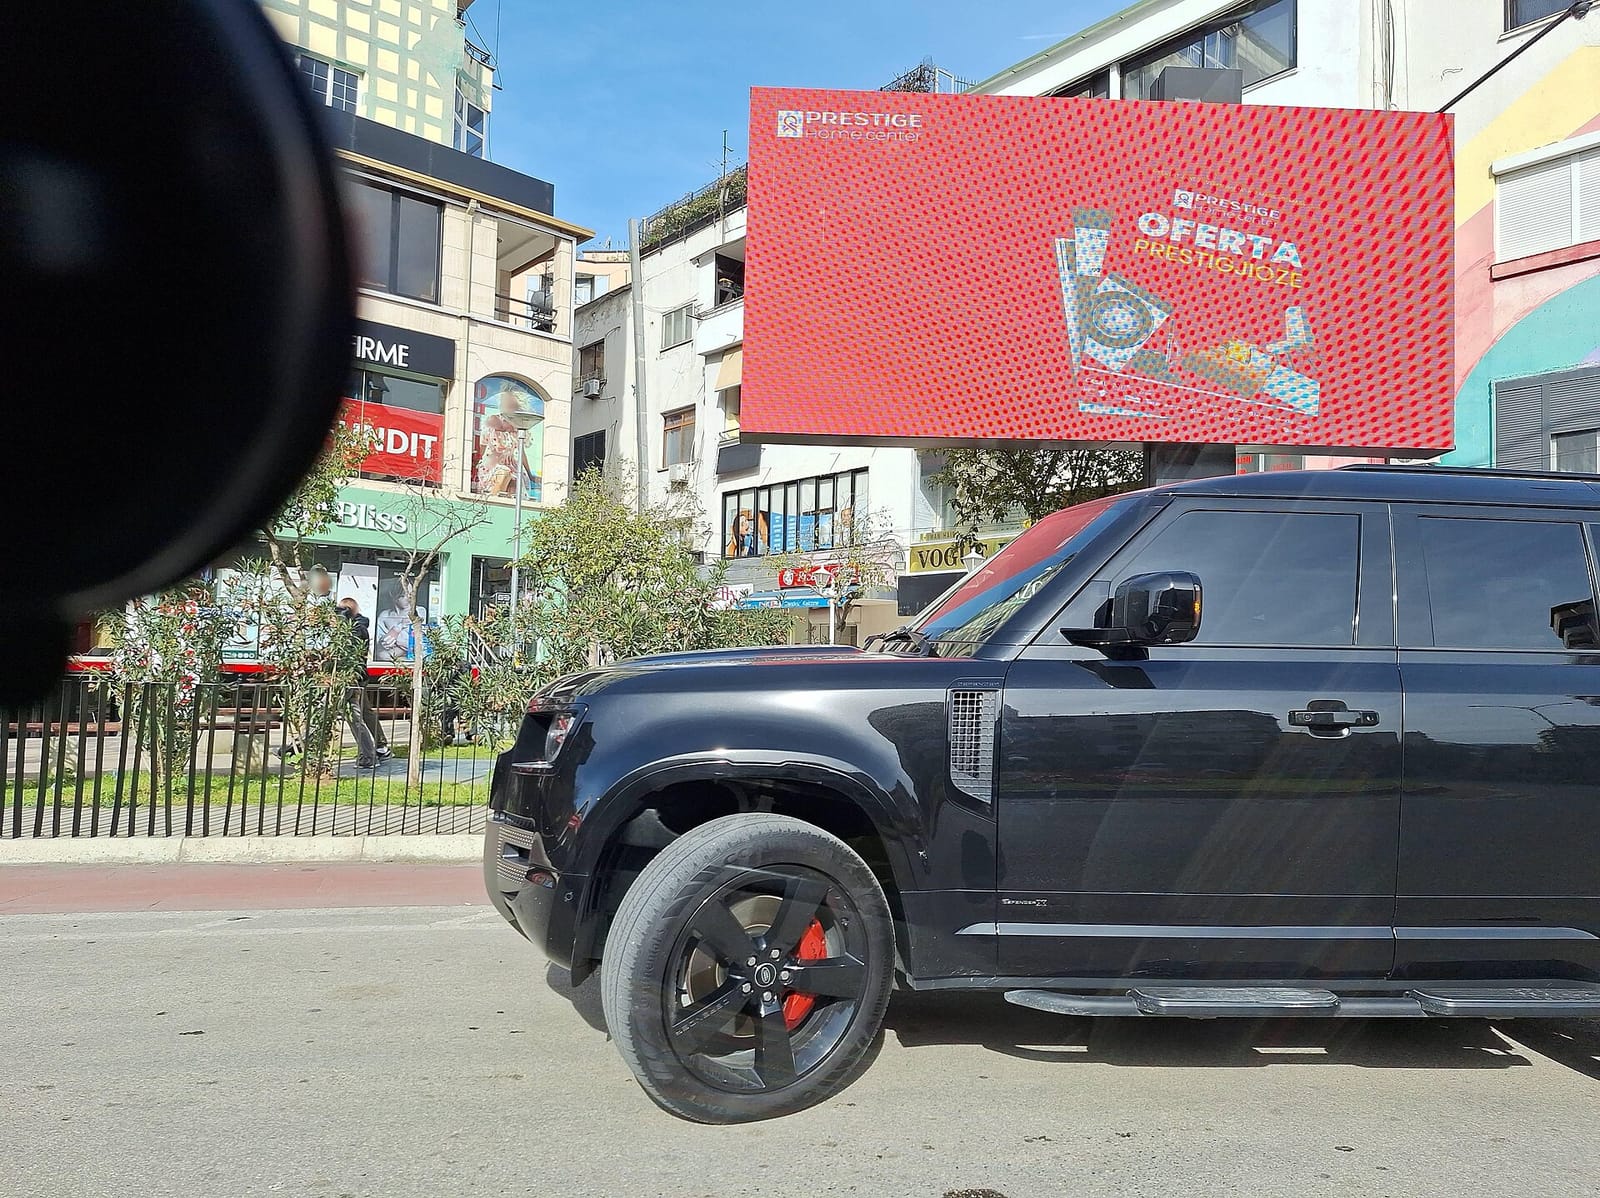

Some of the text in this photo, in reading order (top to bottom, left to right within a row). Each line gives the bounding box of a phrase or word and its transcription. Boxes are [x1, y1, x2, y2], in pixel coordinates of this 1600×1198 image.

[805, 111, 923, 128] PRESTIGE
[805, 129, 921, 142] Home center
[1194, 193, 1280, 220] PRESTIGE
[1138, 212, 1303, 268] OFERTA
[1134, 239, 1303, 289] PRESTIGJIOZE
[353, 335, 409, 367] IRME
